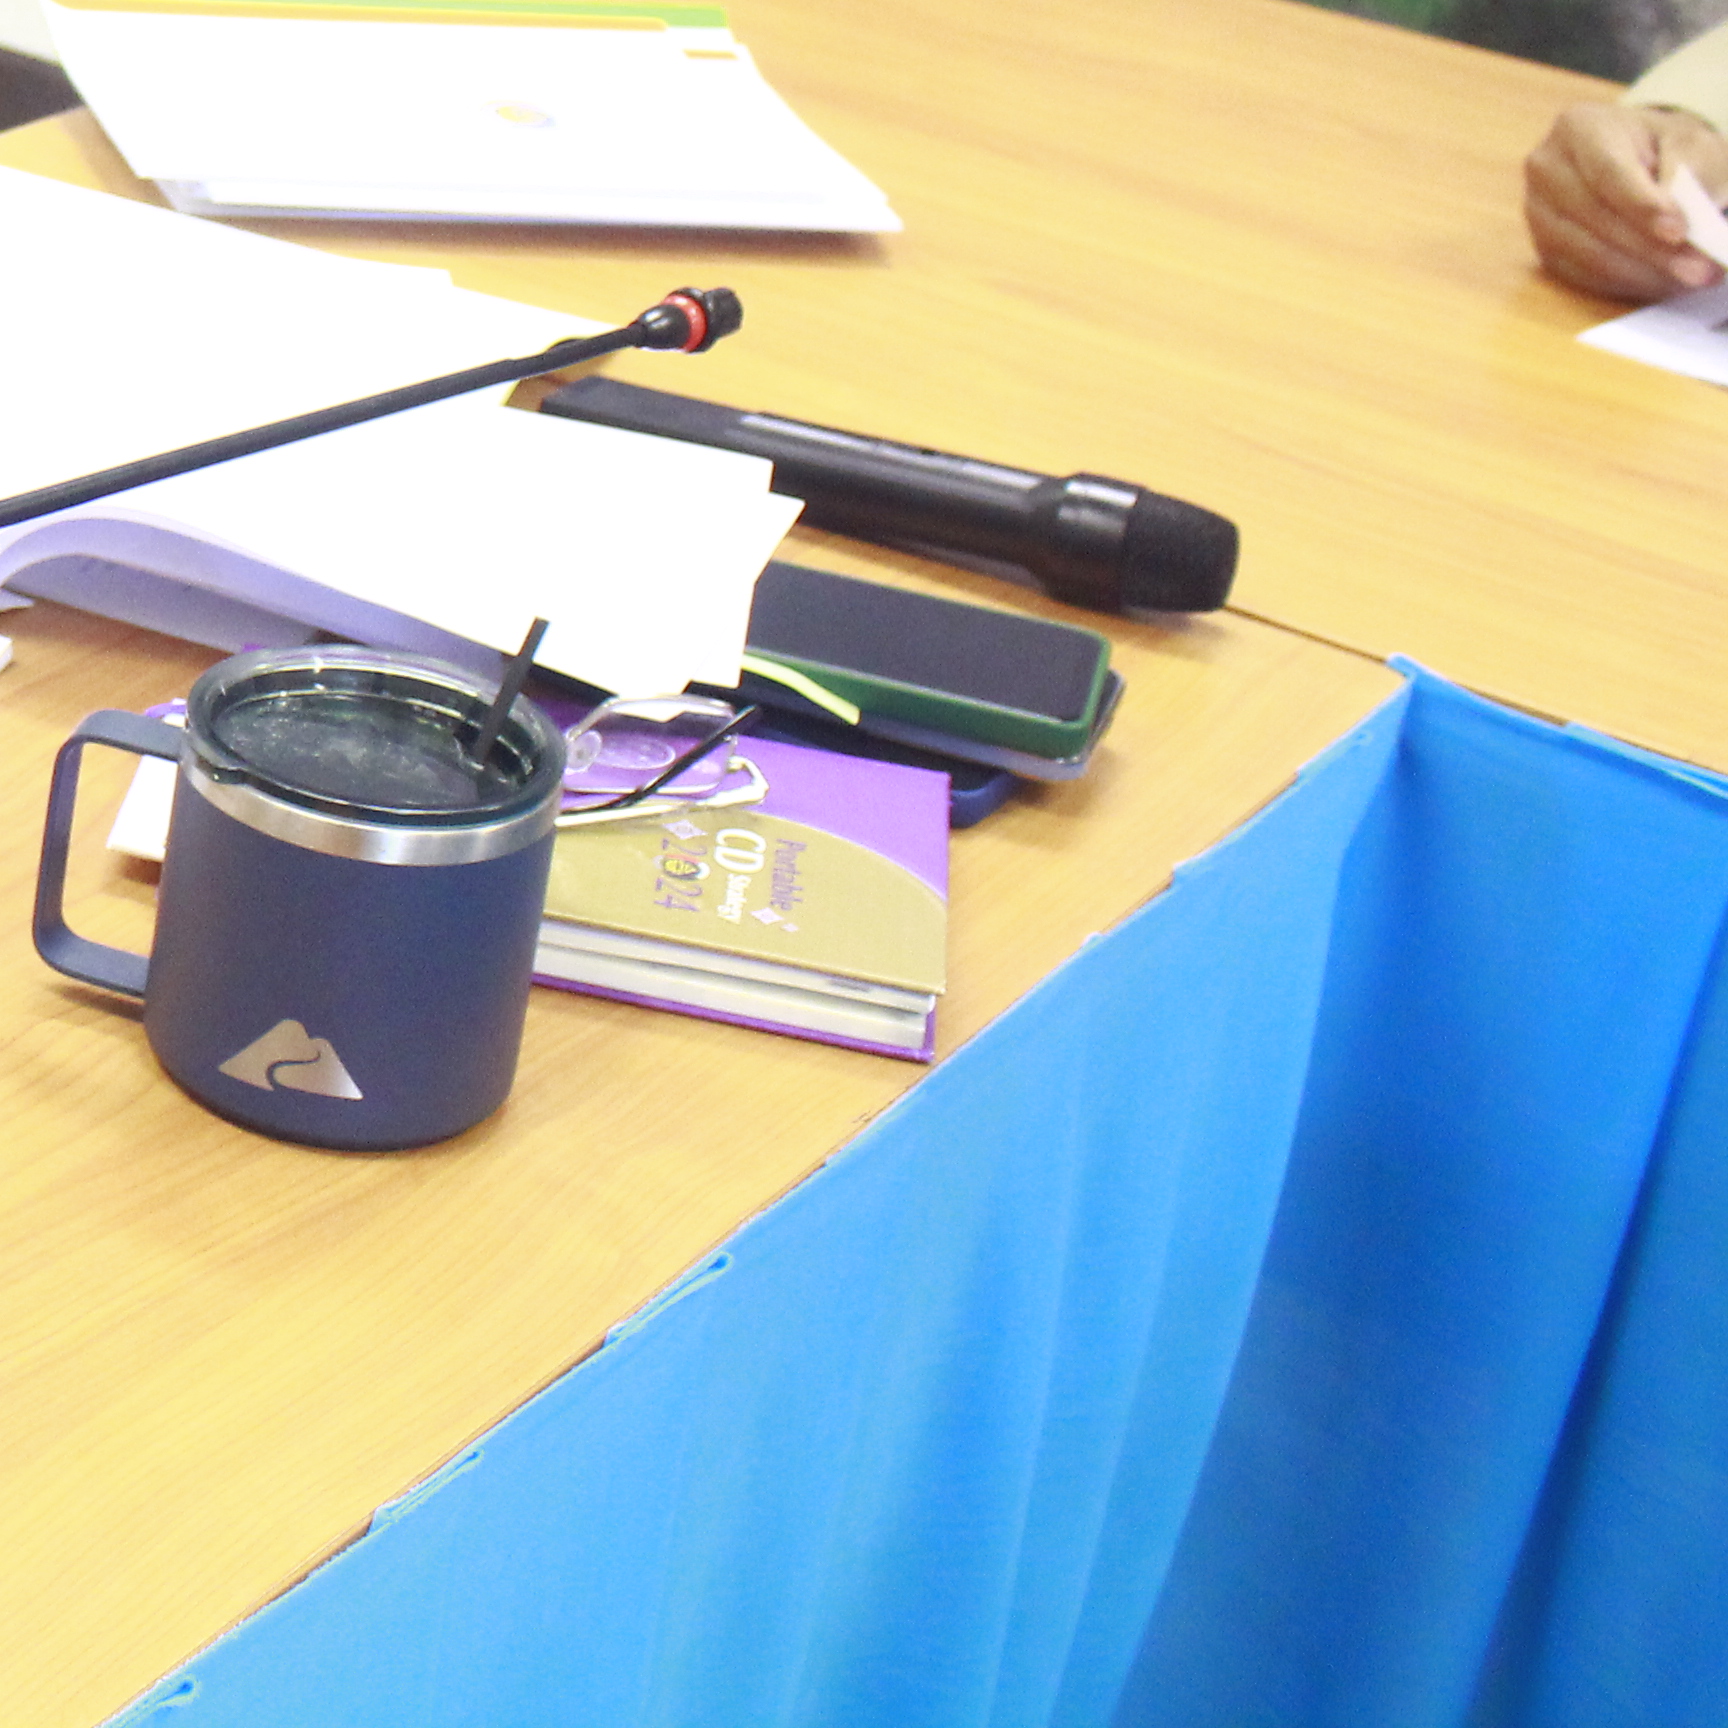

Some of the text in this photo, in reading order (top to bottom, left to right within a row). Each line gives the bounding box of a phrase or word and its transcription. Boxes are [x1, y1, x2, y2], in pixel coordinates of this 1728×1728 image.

[713, 829, 766, 924] CD Strategy
[769, 838, 807, 911] Portable
